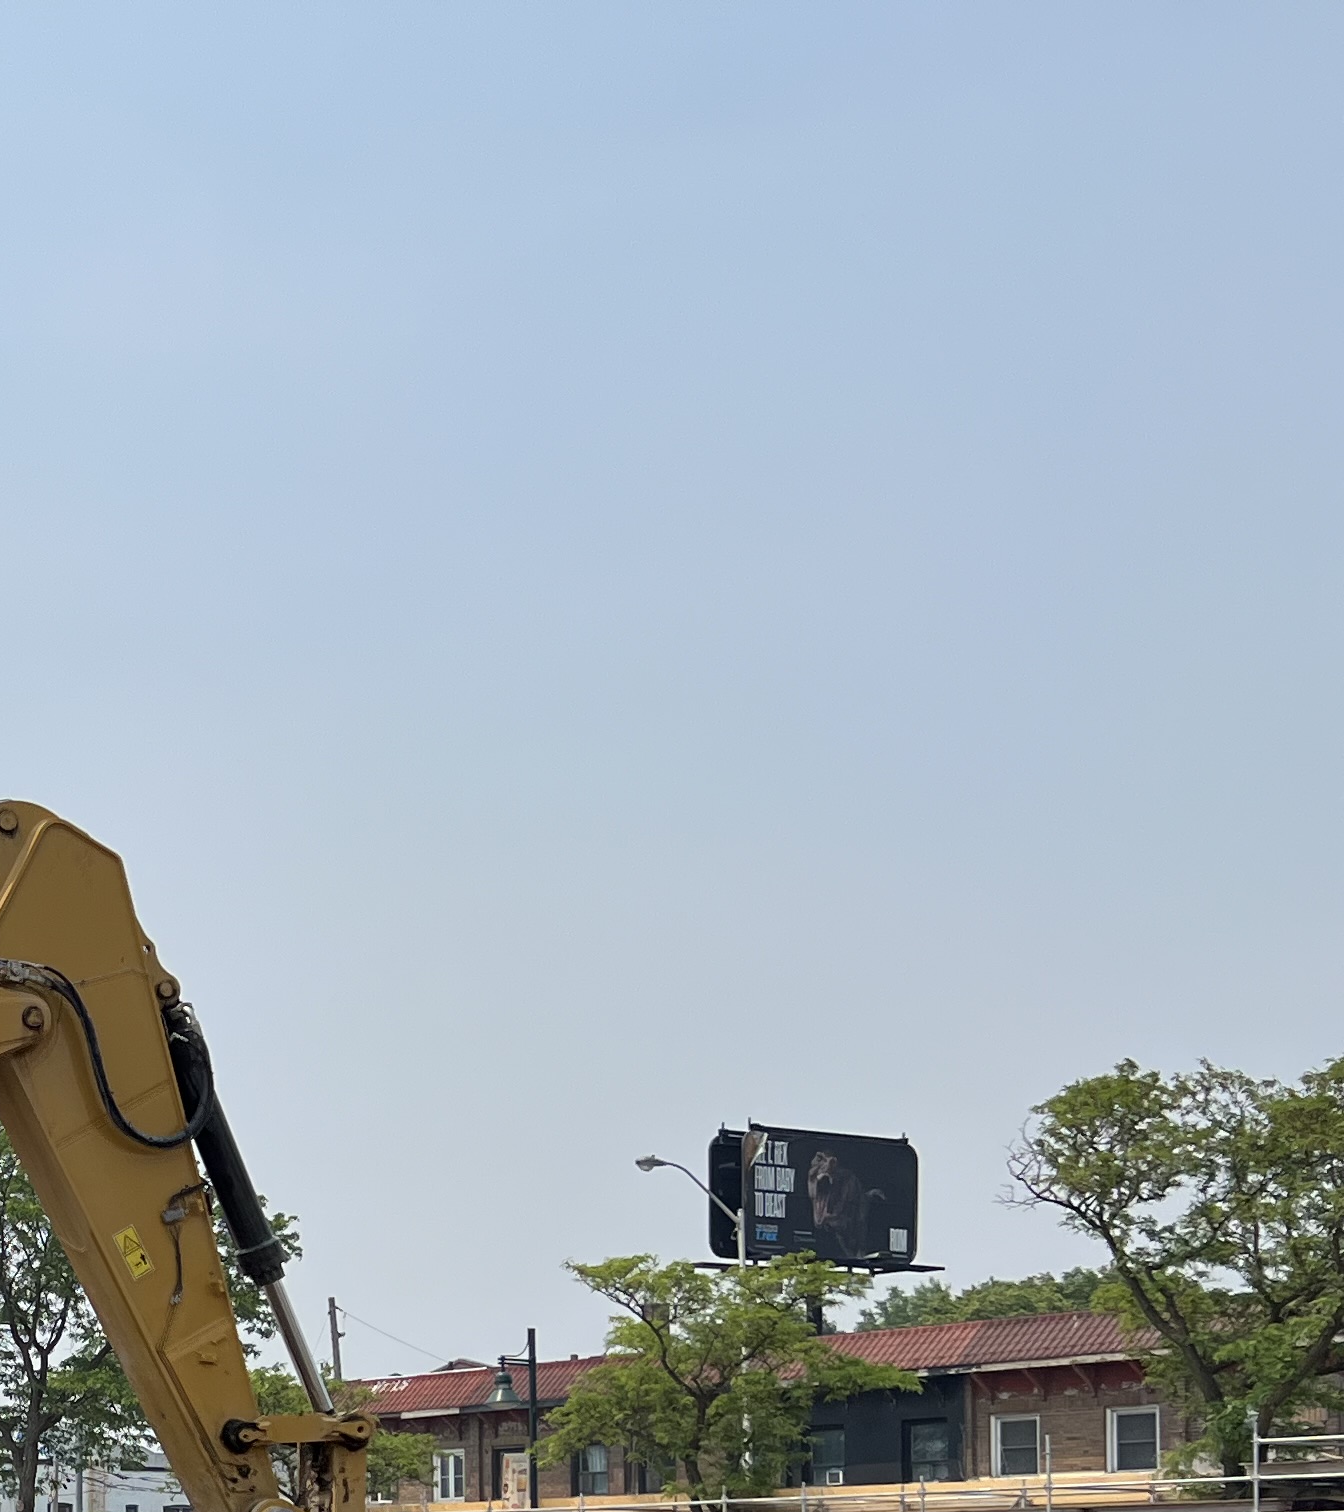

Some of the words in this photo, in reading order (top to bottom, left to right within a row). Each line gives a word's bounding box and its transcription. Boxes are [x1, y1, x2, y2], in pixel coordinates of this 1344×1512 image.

[754, 1165, 775, 1190] FROM
[776, 1168, 796, 1192] BABY
[754, 1192, 763, 1217] TO
